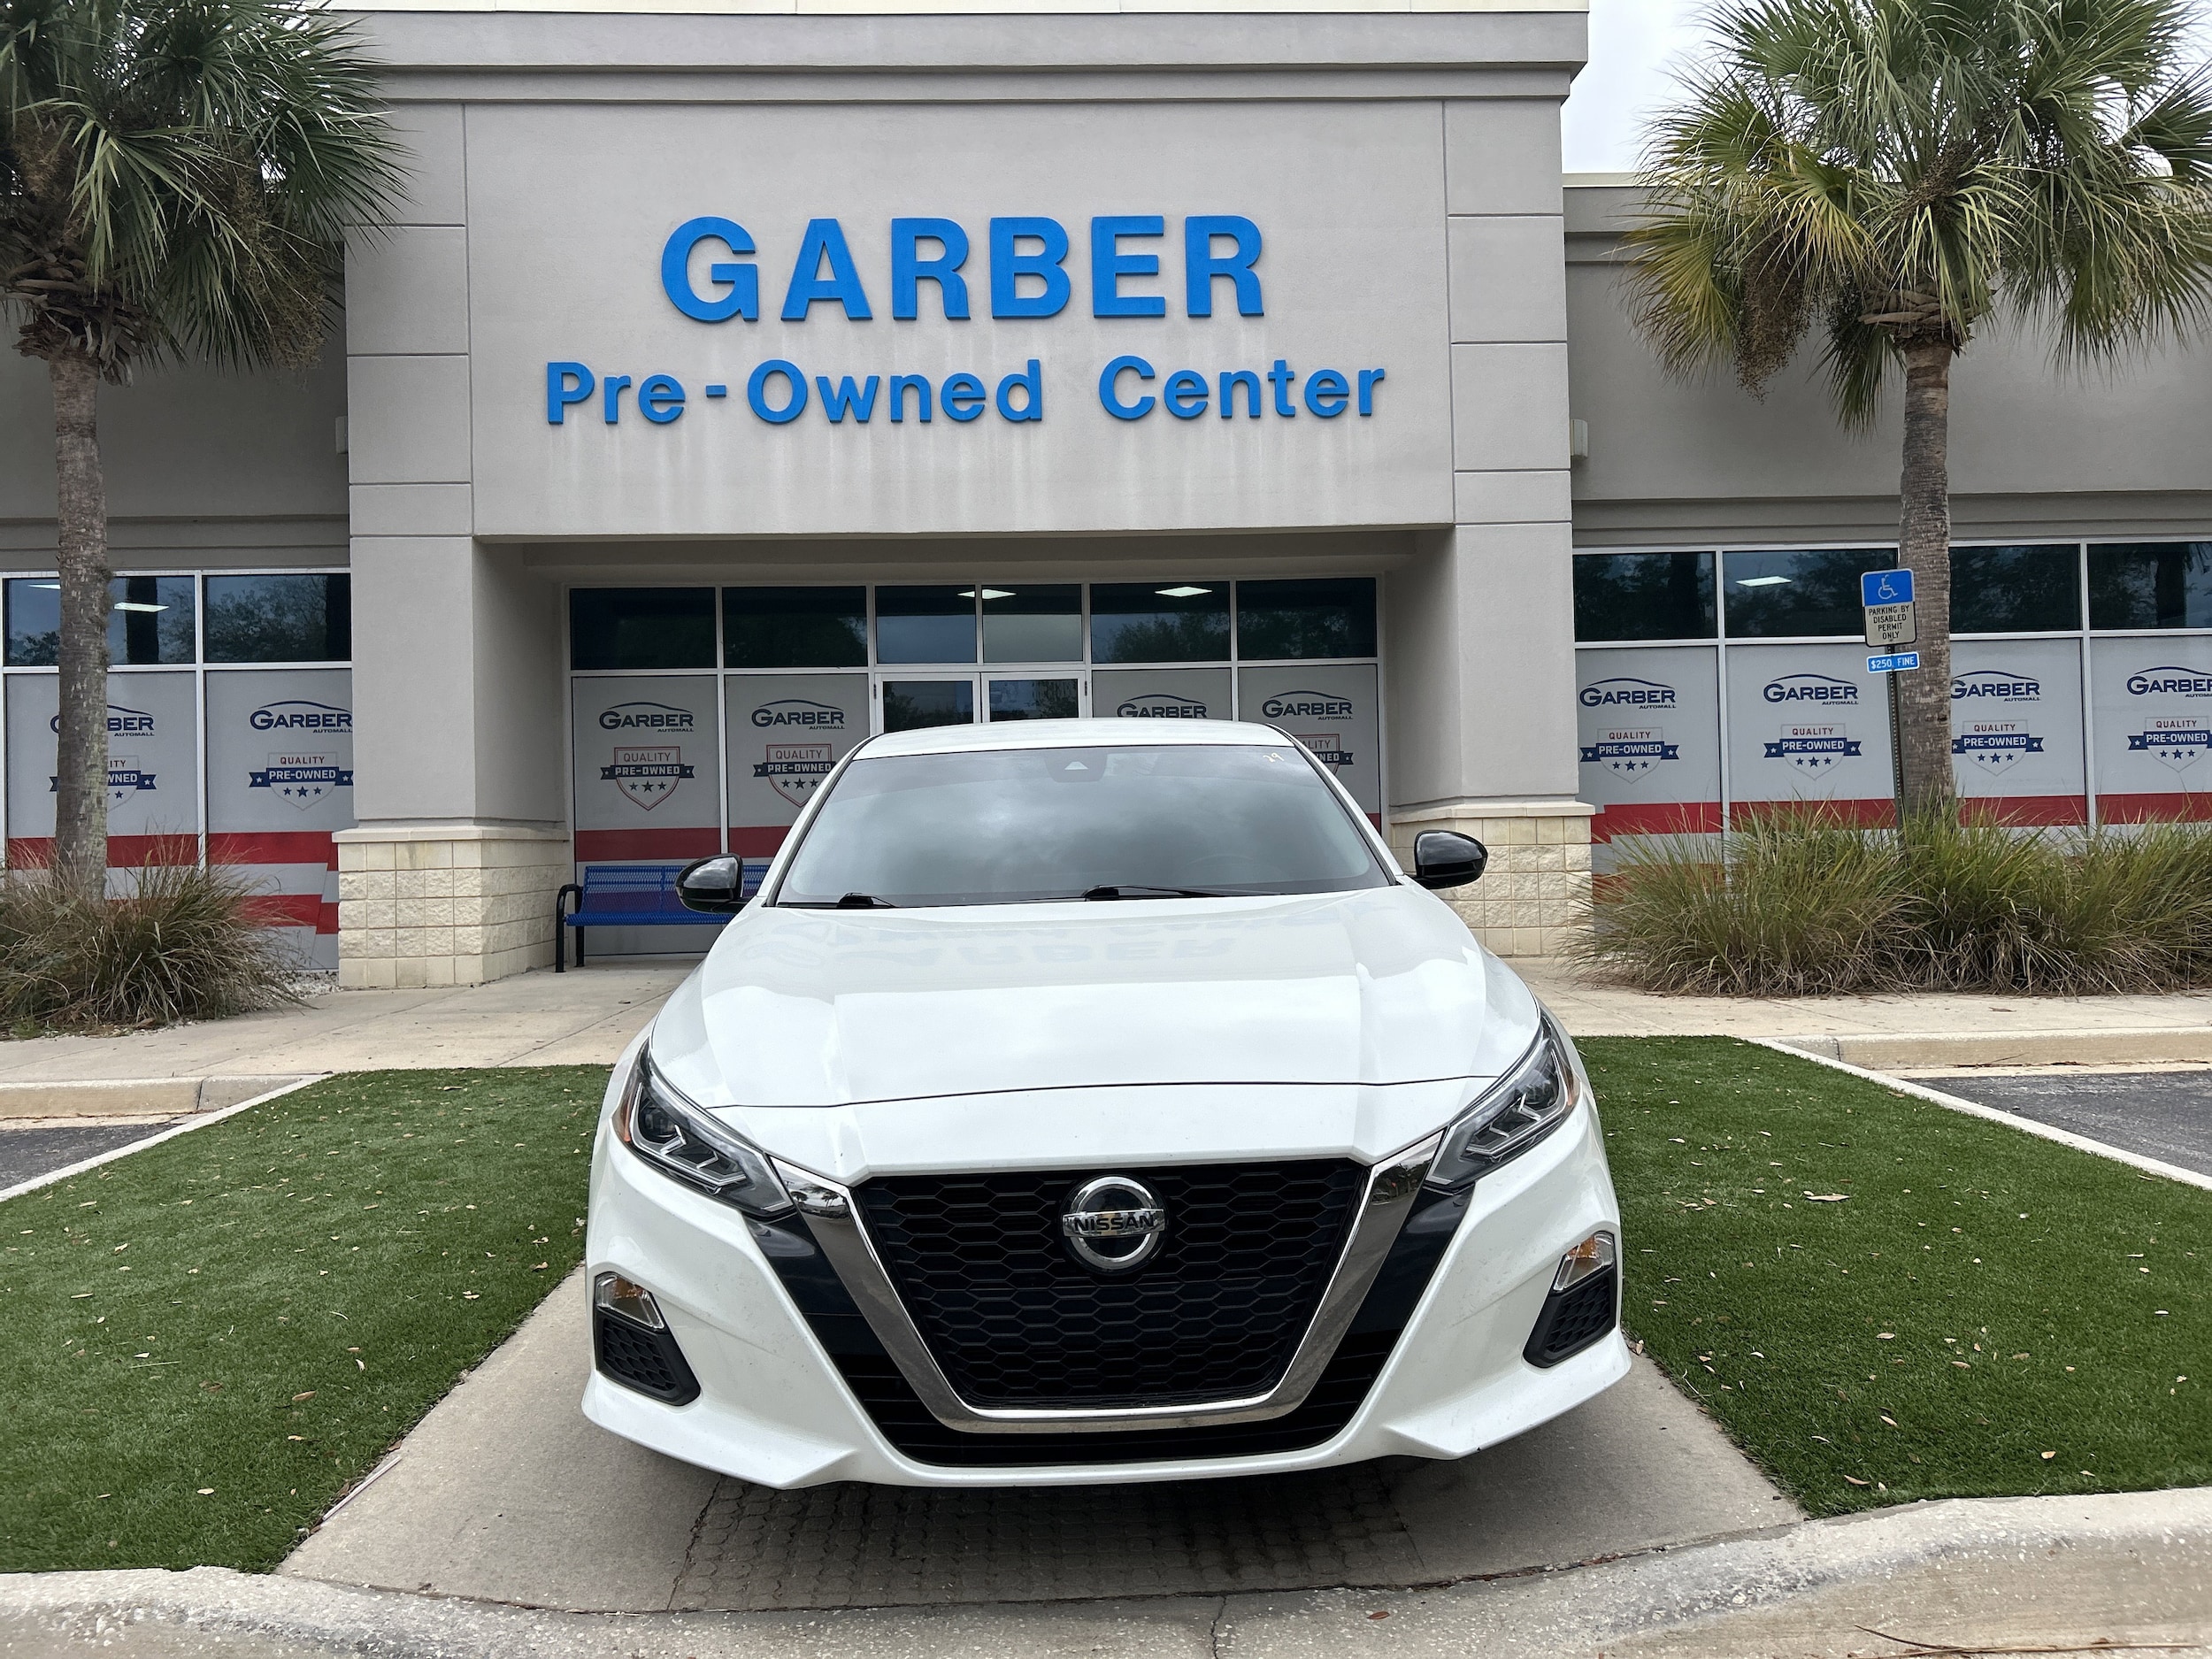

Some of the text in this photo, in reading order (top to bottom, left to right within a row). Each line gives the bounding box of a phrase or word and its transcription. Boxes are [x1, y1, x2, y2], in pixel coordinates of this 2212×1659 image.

[661, 215, 1265, 323] GARBER
[547, 355, 1386, 425] Pre-Owned Center
[1869, 606, 1898, 616] PARKING
[1873, 613, 1907, 624] DISABLED
[1878, 622, 1902, 632] PERMIT
[1882, 631, 1900, 640] ONLY
[1870, 657, 1915, 670] $250 FINE
[1763, 683, 1858, 703] GARBER
[1950, 680, 2040, 699] GARBER
[1579, 687, 1676, 707] GARBER
[1117, 703, 1208, 718] GARBER
[1262, 699, 1353, 718] GARBER
[250, 710, 352, 730] GARBER
[599, 710, 694, 730] GARBER
[751, 708, 845, 727] GARBER
[1792, 727, 1834, 736] QUALITY
[1963, 737, 2027, 747] PRE-OWNED
[2146, 733, 2208, 743] PRE-OWNED
[1598, 744, 1662, 755] PRE-OWNED
[1782, 741, 1845, 750] PRE-OWNED
[624, 752, 671, 762] QUALITY
[775, 749, 822, 759] QUALITY
[280, 757, 326, 765] QUALITY
[615, 765, 680, 776] PRE-OWNED
[767, 763, 832, 772] PRE-OWNED
[268, 770, 336, 780] PRE-OWNED
[1073, 1214, 1155, 1232] NISSAN
